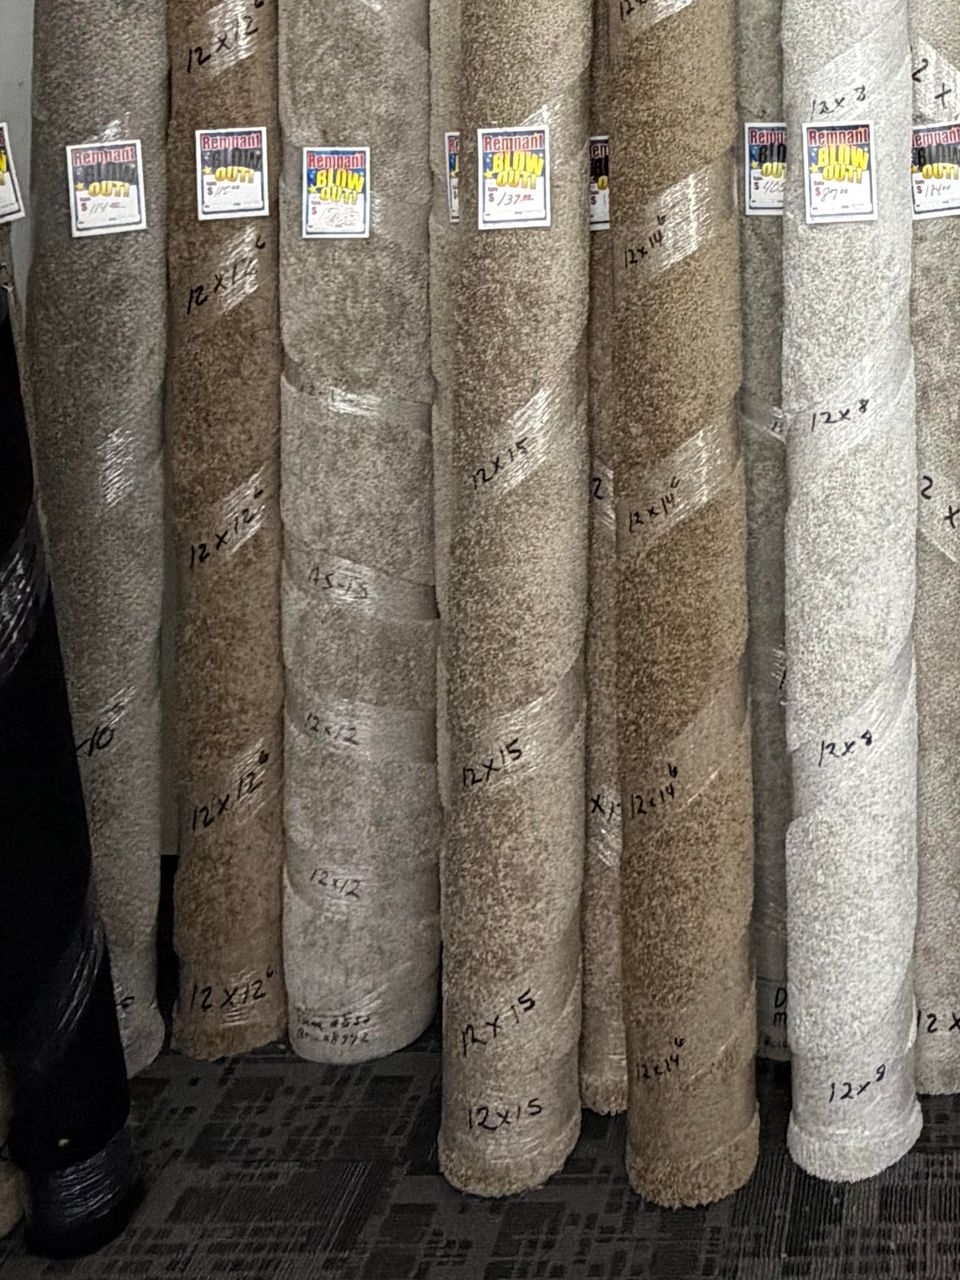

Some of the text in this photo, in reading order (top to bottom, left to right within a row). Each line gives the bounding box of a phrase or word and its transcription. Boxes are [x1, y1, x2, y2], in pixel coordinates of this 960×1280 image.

[202, 133, 261, 150] Remnant
[484, 133, 543, 152] Remnant
[809, 127, 868, 144] Remnant
[74, 147, 135, 165] Remnant
[308, 153, 364, 168] Remnant
[492, 150, 544, 176] BLOW
[818, 144, 869, 170] BLOW
[315, 167, 364, 193] BLOW
